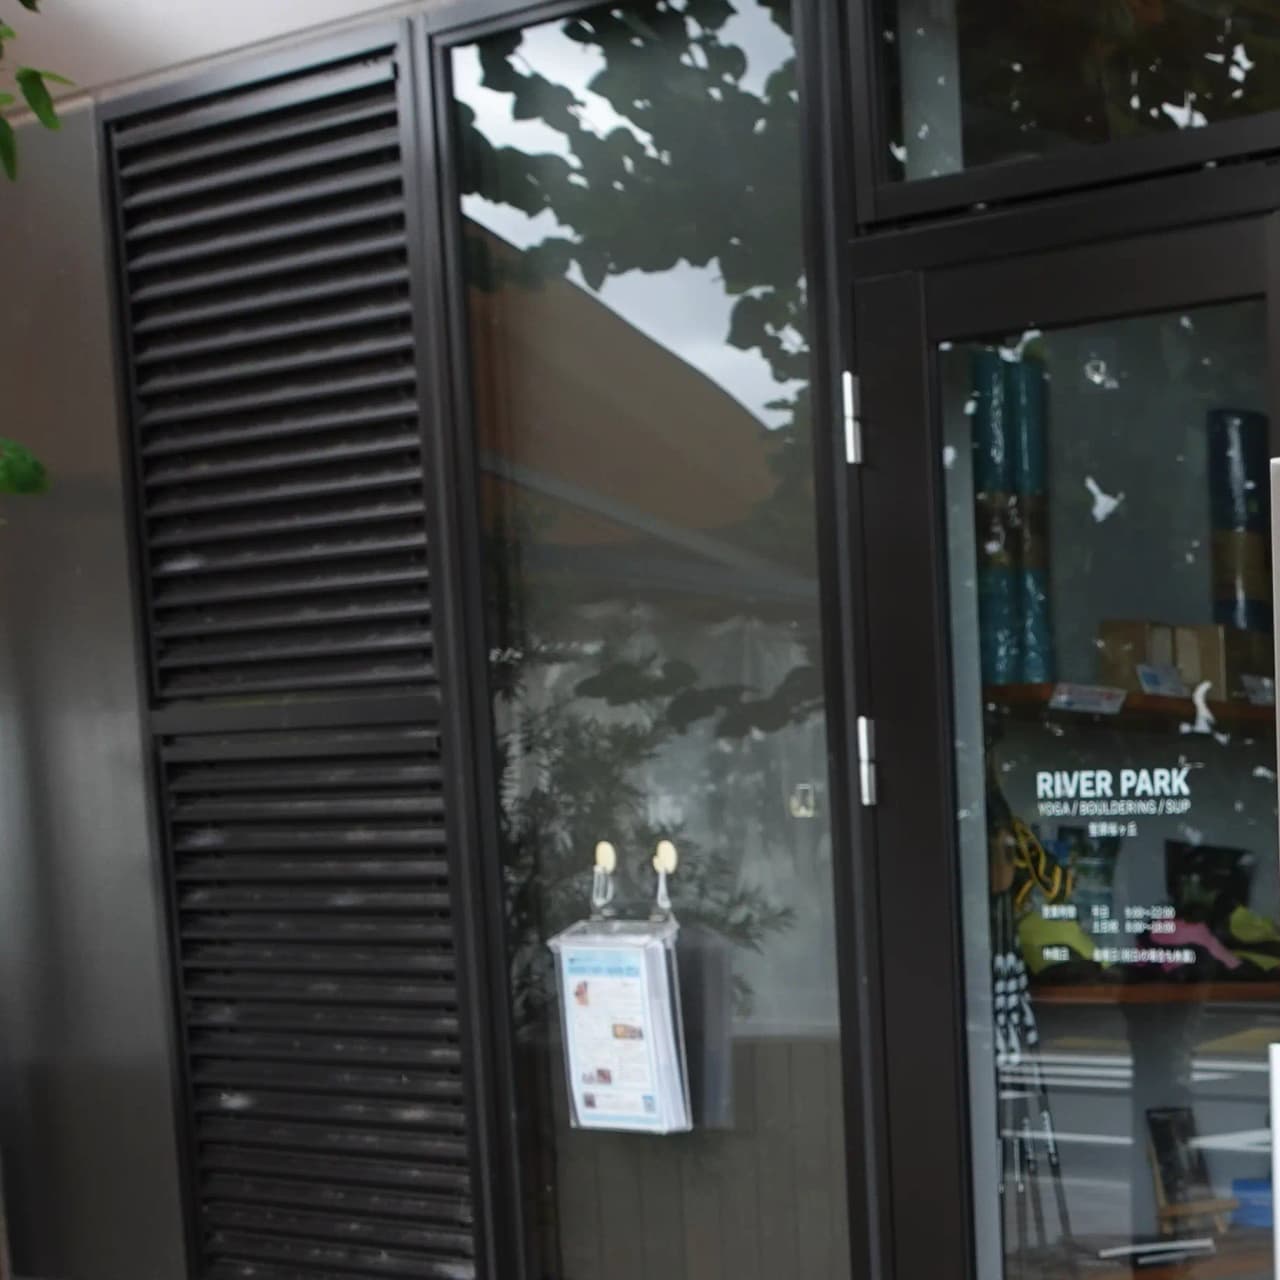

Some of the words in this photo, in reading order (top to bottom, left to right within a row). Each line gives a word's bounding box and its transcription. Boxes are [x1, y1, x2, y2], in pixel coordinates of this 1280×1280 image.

[1036, 769, 1113, 799] RIVER
[1120, 767, 1191, 798] PARK
[1037, 800, 1070, 816] YOGA
[1079, 799, 1156, 816] BOULDERING
[1166, 798, 1191, 815] SUP
